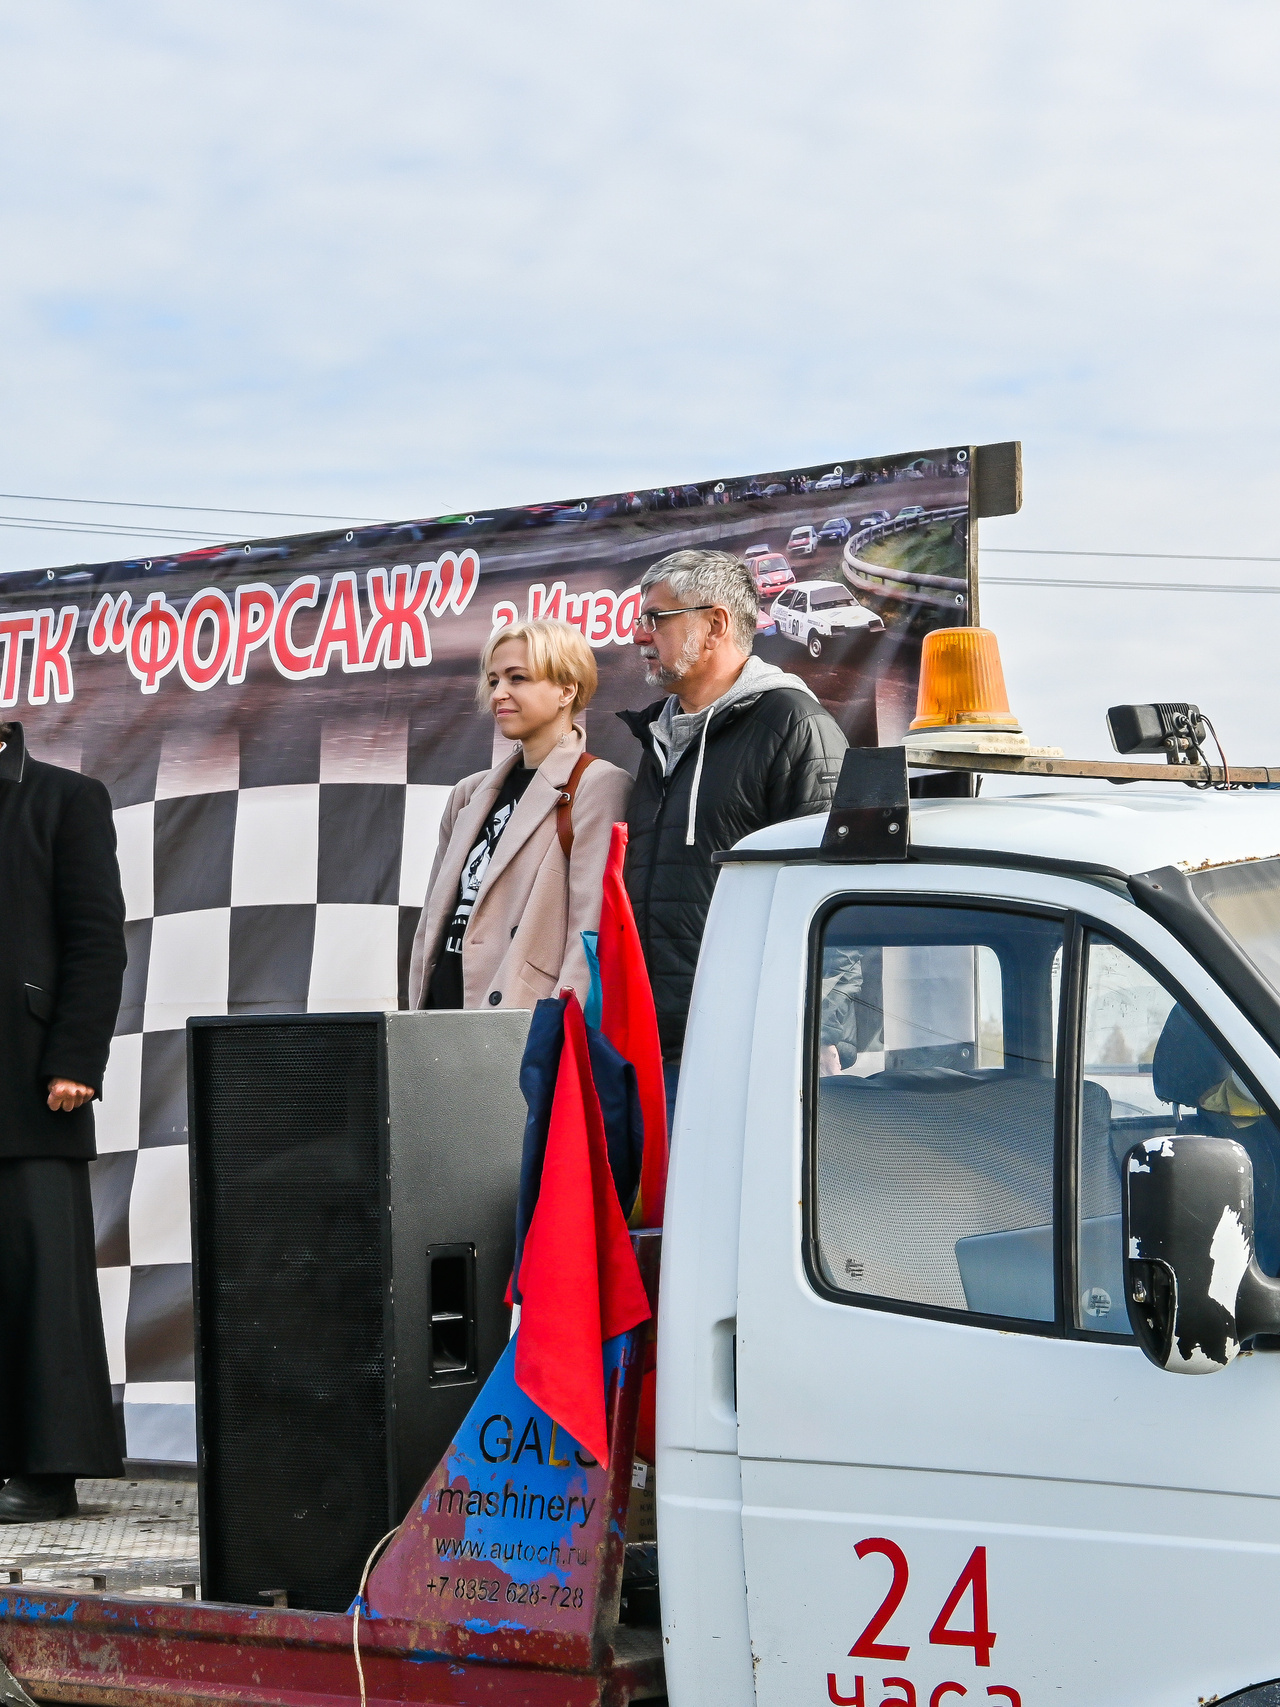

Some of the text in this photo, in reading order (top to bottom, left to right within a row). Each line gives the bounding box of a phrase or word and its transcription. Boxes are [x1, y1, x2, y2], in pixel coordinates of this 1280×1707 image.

[436, 1483, 596, 1528] mashinery
[435, 1537, 589, 1566] www.autoch.ru
[426, 1576, 584, 1609] +7 8352 628-728
[847, 1537, 997, 1667] 24
